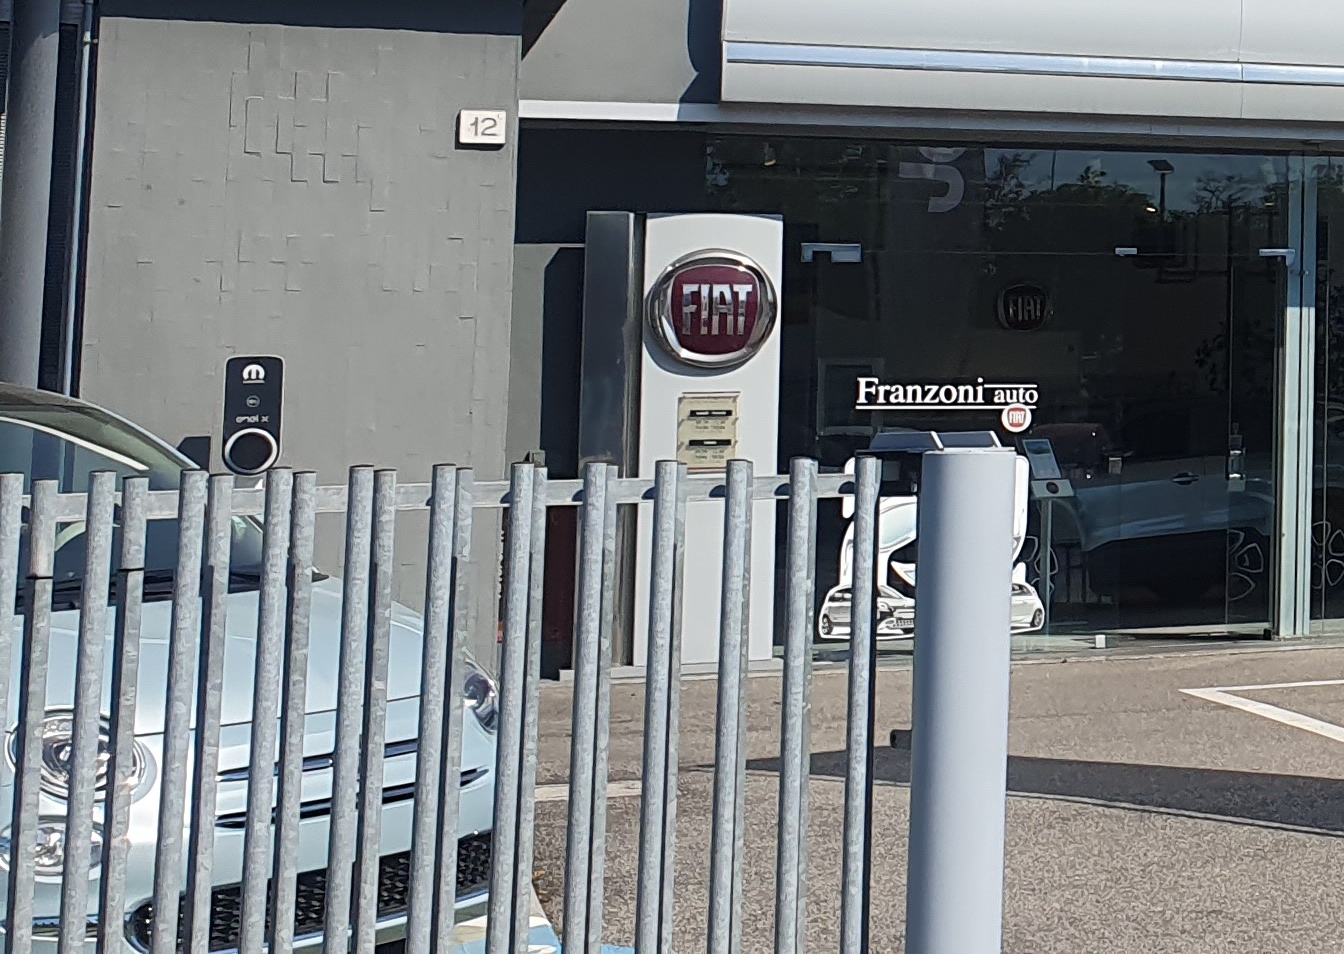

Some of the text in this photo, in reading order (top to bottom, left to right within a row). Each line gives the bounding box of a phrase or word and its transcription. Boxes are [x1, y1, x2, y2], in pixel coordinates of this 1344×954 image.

[470, 116, 499, 136] 12
[682, 283, 753, 335] FIAT
[856, 377, 1039, 403] Franzoni auto
